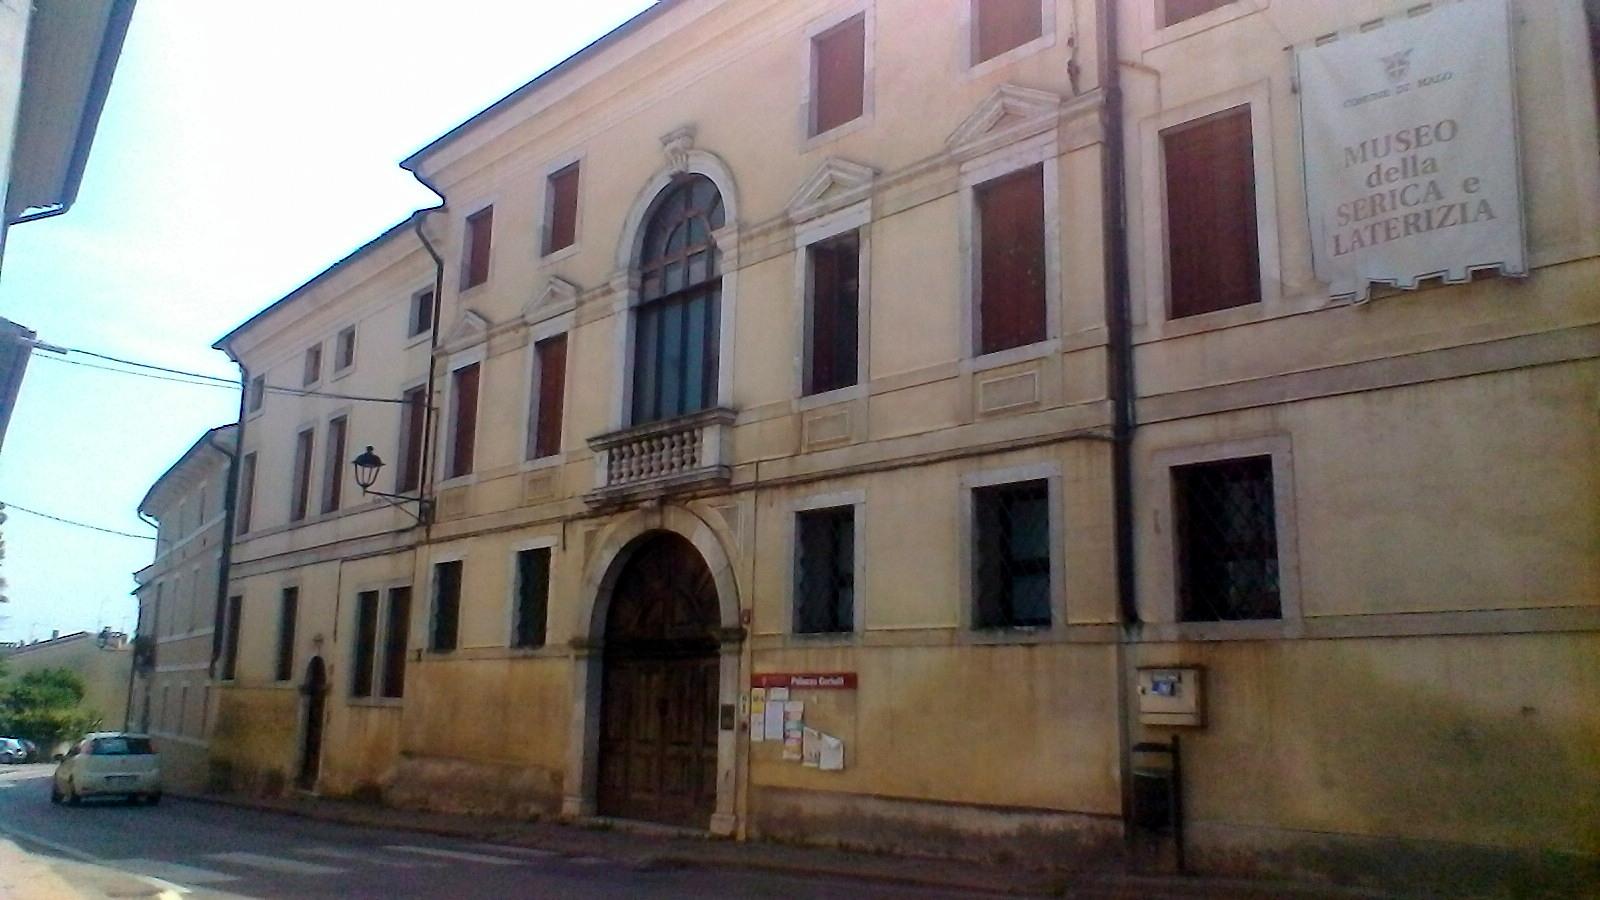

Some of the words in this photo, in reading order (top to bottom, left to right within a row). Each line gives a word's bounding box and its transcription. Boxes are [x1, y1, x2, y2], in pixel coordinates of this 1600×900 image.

[1344, 118, 1458, 168] MUSEO
[1366, 155, 1438, 188] della
[1336, 180, 1443, 227] SERICA
[1463, 176, 1480, 194] e
[1333, 198, 1496, 256] LATERIZIA
